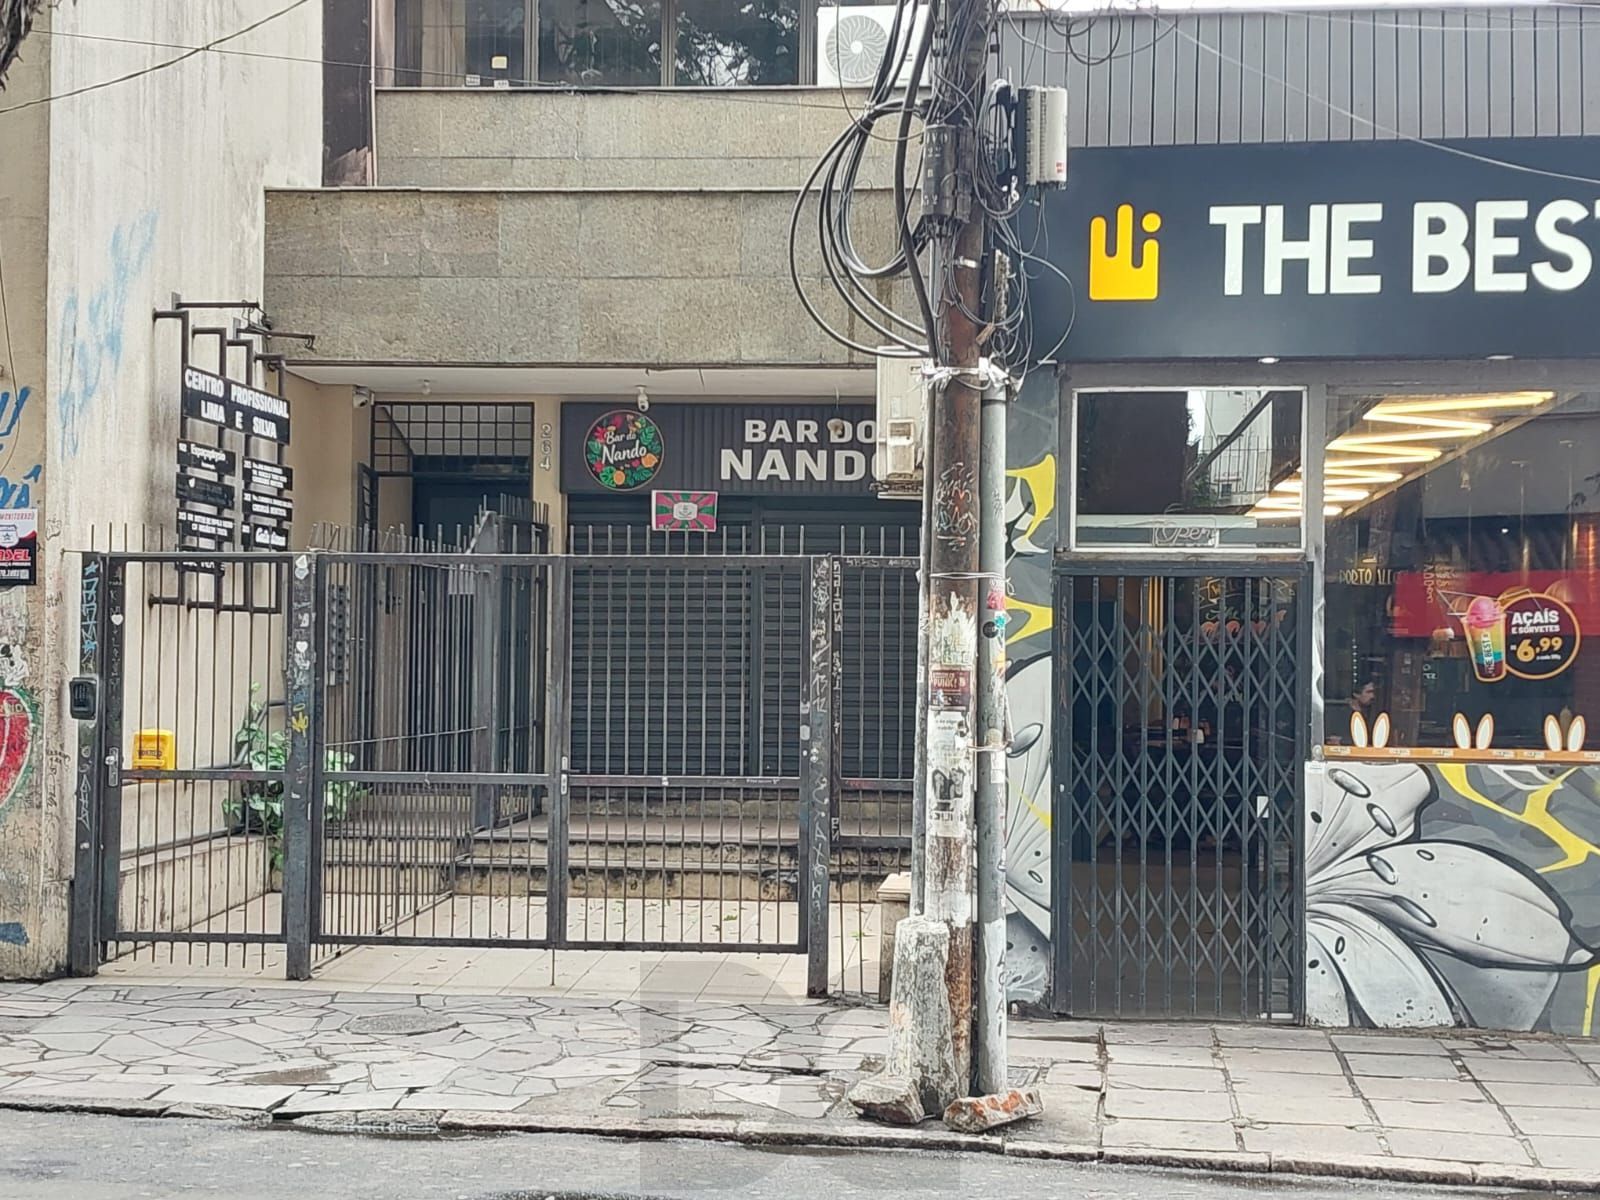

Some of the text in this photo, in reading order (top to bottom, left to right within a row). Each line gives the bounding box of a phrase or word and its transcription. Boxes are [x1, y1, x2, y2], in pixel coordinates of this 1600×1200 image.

[1209, 199, 1600, 296] THE BES
[185, 369, 289, 419] CENTRO PROFISSIONAL
[201, 400, 277, 439] LIMA E SILVA
[744, 419, 876, 443] BAR DO
[541, 423, 552, 471] 264
[605, 431, 626, 444] Bar
[602, 440, 647, 464] Nando
[720, 449, 876, 481] NAND
[1511, 608, 1559, 627] AÇAÍS
[1519, 624, 1560, 634] SORVETES
[1516, 637, 1562, 662] 6,99
